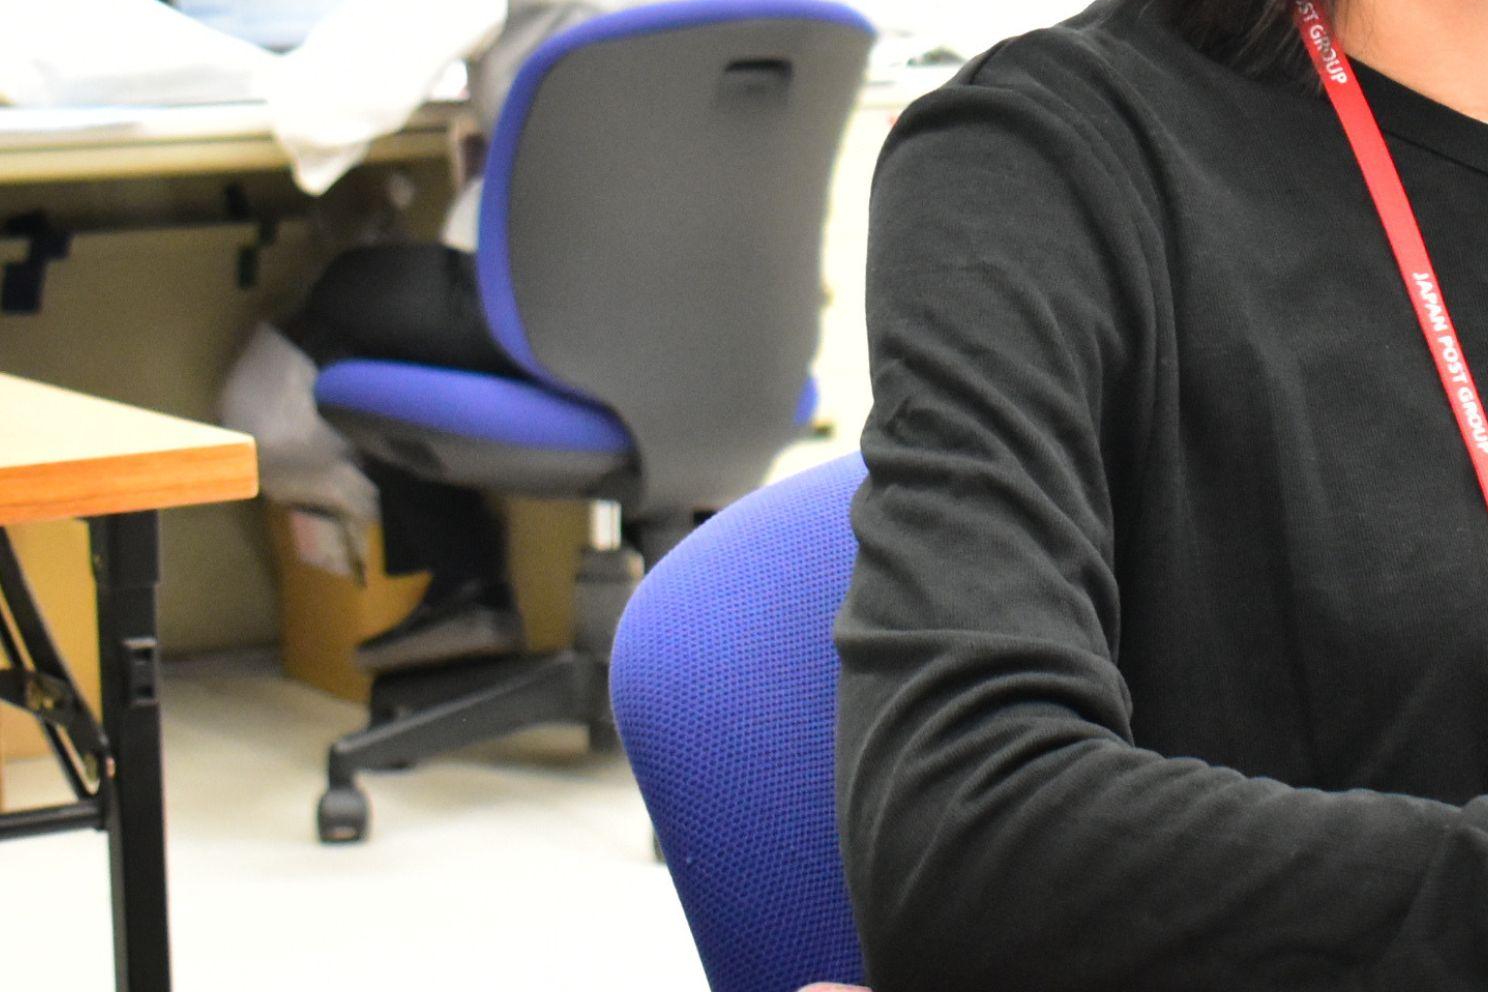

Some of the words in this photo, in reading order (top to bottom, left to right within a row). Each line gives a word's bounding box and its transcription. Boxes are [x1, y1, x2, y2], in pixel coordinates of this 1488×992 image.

[1309, 24, 1348, 84] GROUP
[1412, 272, 1449, 332] JAPAN
[1437, 335, 1468, 383] POST
